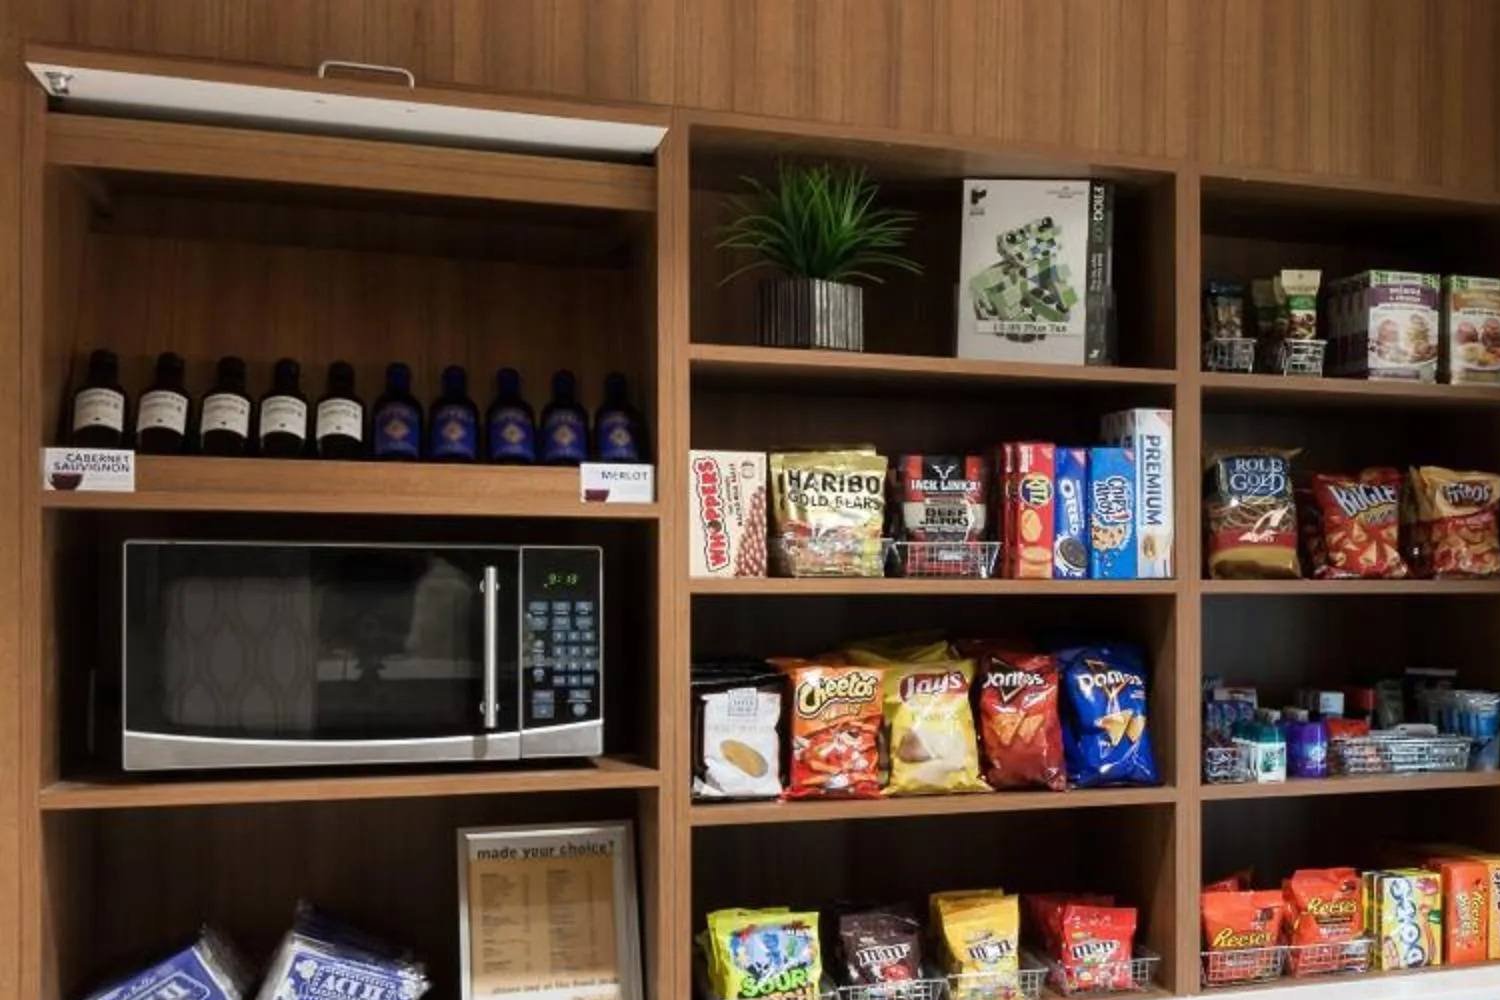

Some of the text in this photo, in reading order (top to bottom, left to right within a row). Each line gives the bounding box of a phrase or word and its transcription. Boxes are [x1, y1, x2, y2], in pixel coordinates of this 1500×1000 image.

[54, 461, 130, 473] SAUVIGNON
[66, 453, 129, 463] CABERNET
[1235, 458, 1283, 473] ROLD
[601, 471, 648, 481] MERLOT
[787, 470, 881, 495] HARIBO
[1146, 435, 1162, 525] PREMIUM
[1230, 473, 1285, 493] GOLD
[788, 490, 882, 511] GOLD BEARS
[1060, 478, 1079, 535] OREO
[697, 461, 727, 567] WHOPPERS
[797, 672, 878, 715] Cheetos
[477, 840, 615, 861] made your choice?
[320, 975, 361, 995] ACT
[742, 966, 809, 998] SOUR
